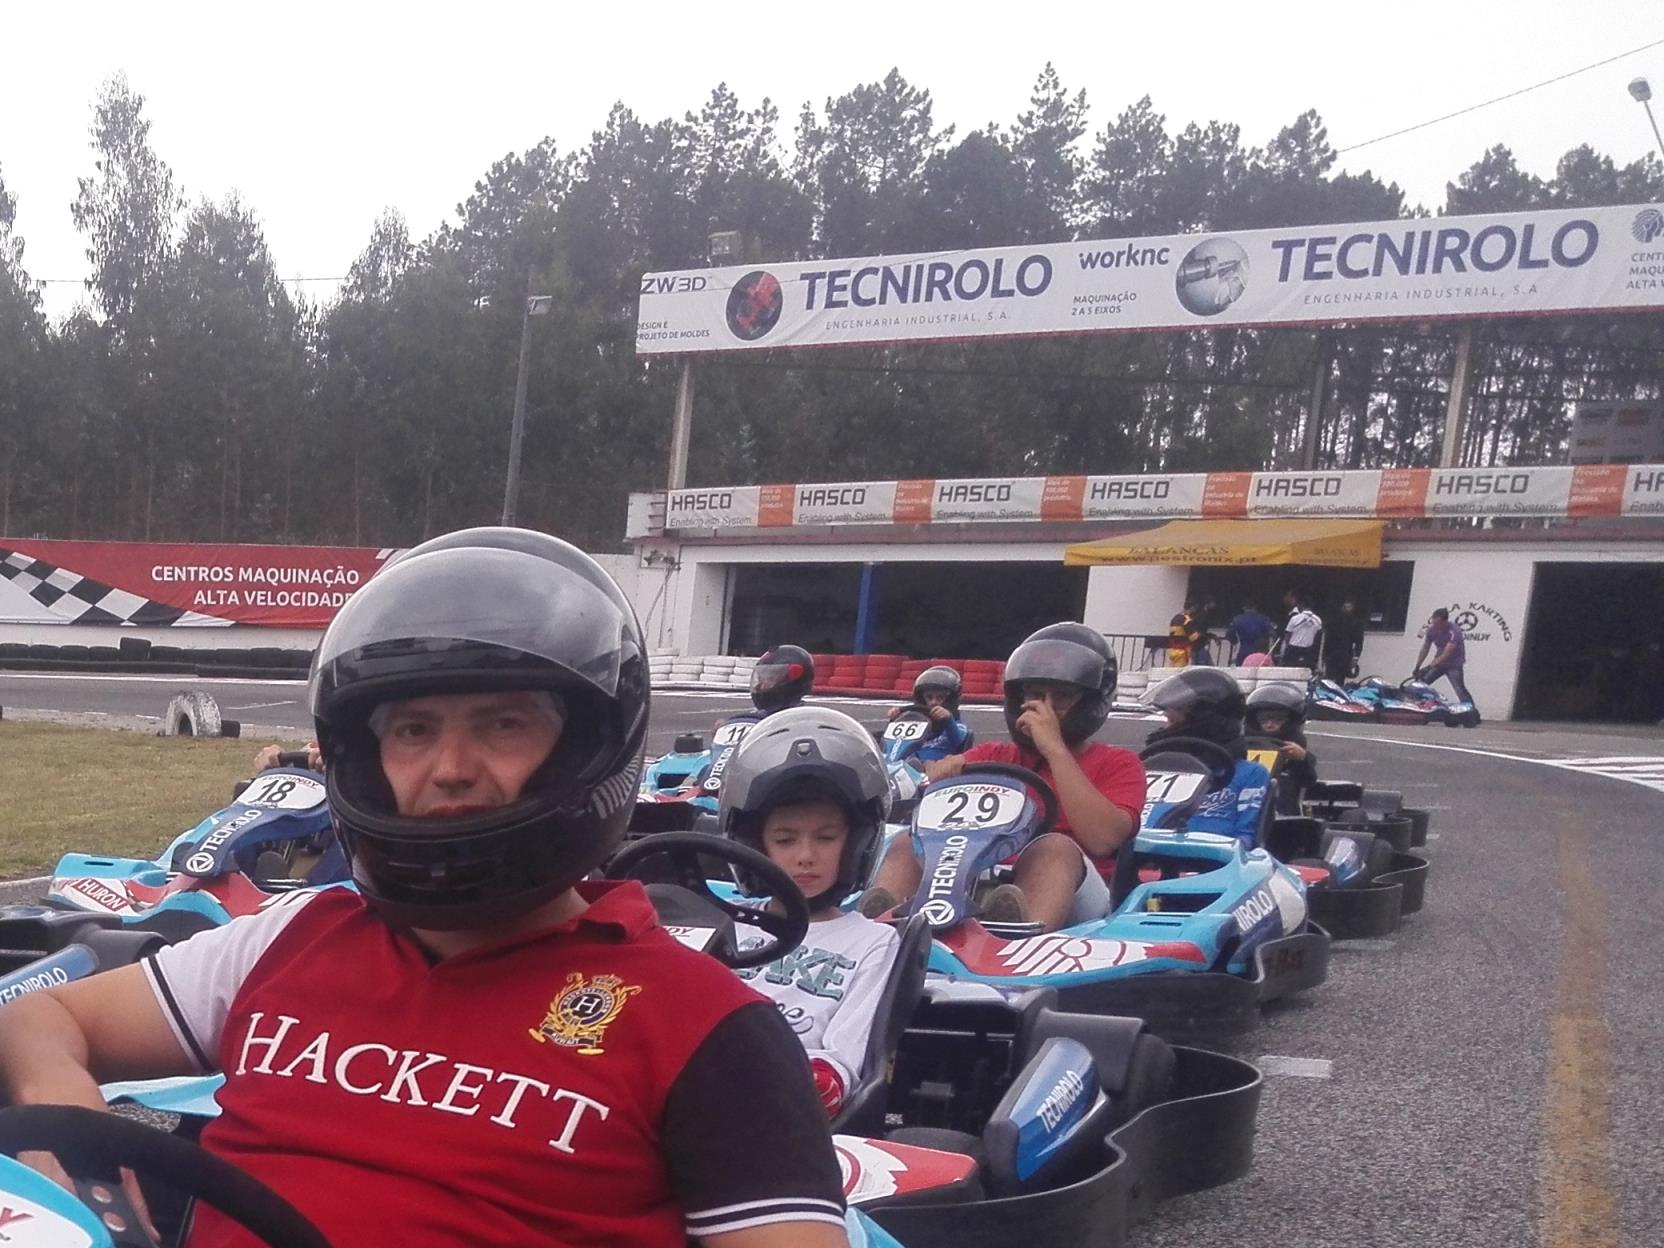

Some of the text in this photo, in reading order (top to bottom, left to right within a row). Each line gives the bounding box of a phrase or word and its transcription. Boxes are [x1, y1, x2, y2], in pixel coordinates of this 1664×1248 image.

[1079, 243, 1170, 270] worknc
[1272, 219, 1599, 283] TECNIROLO
[1631, 252, 1664, 262] CENT
[641, 276, 707, 295] ZW3D
[799, 254, 1053, 311] TECNIROLO
[1626, 280, 1656, 289] ALTA
[1073, 290, 1137, 304] MAQUINAÇÃO
[1304, 291, 1398, 304] ENGENHARIA
[1071, 308, 1078, 316] 2
[1094, 305, 1122, 315] EIXOS
[825, 317, 901, 330] ENGENHARIA
[680, 329, 710, 338] MOLDES
[938, 484, 1011, 503] HASCO
[1090, 481, 1170, 500] HASCO
[1255, 478, 1342, 497] HASCO
[1435, 474, 1530, 495] HASCO
[671, 493, 732, 511] HASCO
[799, 488, 866, 507] HASCO
[150, 564, 360, 588] CENTROS MAQUINAÇÃO
[193, 589, 239, 607] ALTA
[1468, 602, 1513, 642] KARTING
[728, 726, 747, 742] 11
[892, 723, 918, 737] 66
[710, 746, 735, 777] TECNOLO
[248, 780, 296, 804] 18
[1146, 774, 1180, 799] 71
[941, 792, 1001, 824] 29
[77, 879, 126, 909] HURON
[574, 995, 601, 1014] H
[236, 1010, 610, 1155] HACKETT
[1035, 1070, 1084, 1134] TECNIROLO
